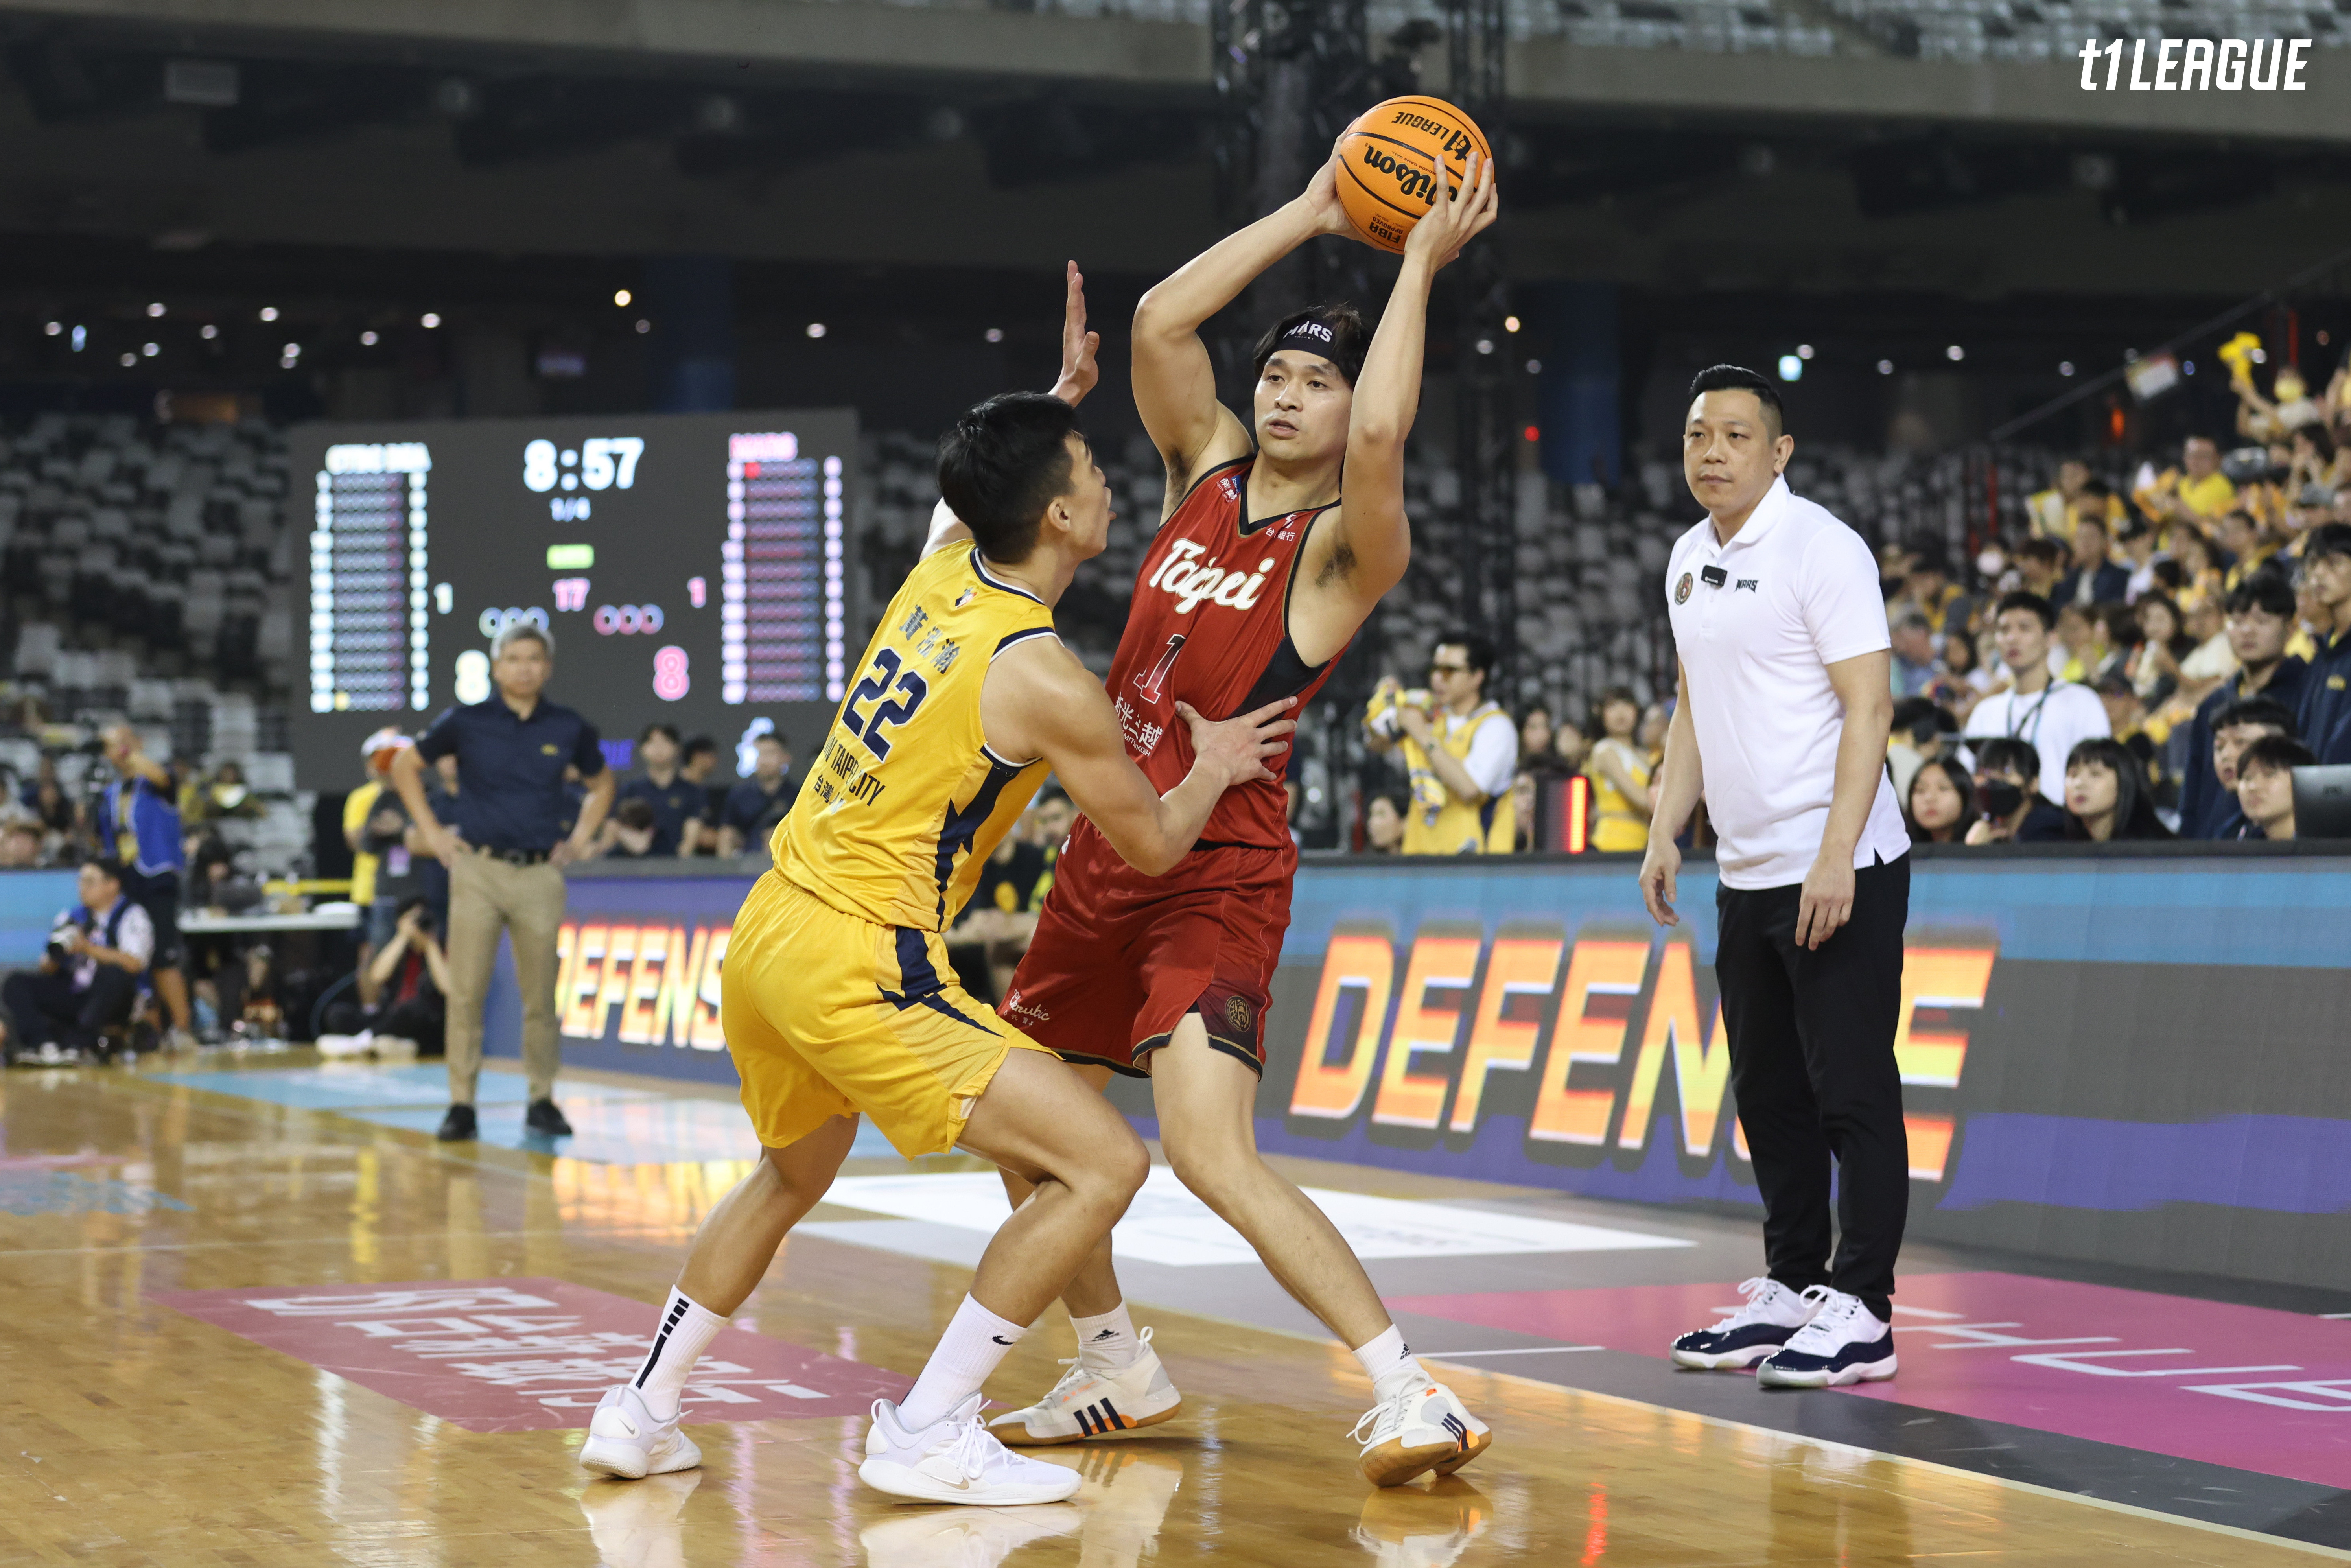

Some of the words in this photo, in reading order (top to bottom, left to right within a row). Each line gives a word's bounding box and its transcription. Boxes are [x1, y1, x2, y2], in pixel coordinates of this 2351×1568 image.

[1391, 112, 1449, 140] LEAGUE
[1369, 221, 1401, 243] FIBA
[1373, 217, 1403, 234] APPROVED
[1283, 320, 1332, 343] MARS
[523, 437, 645, 492] 8:57
[1265, 527, 1295, 542] 台銀行
[552, 577, 591, 612] 17
[1148, 538, 1276, 614] Taipei
[653, 645, 691, 701] 8
[1133, 633, 1186, 705] 1
[842, 645, 929, 764] 22
[1123, 733, 1151, 757] MITSUKOSH
[849, 769, 886, 807] CITY
[554, 922, 736, 1052] EFENS
[1289, 935, 1999, 1181] DEFENE
